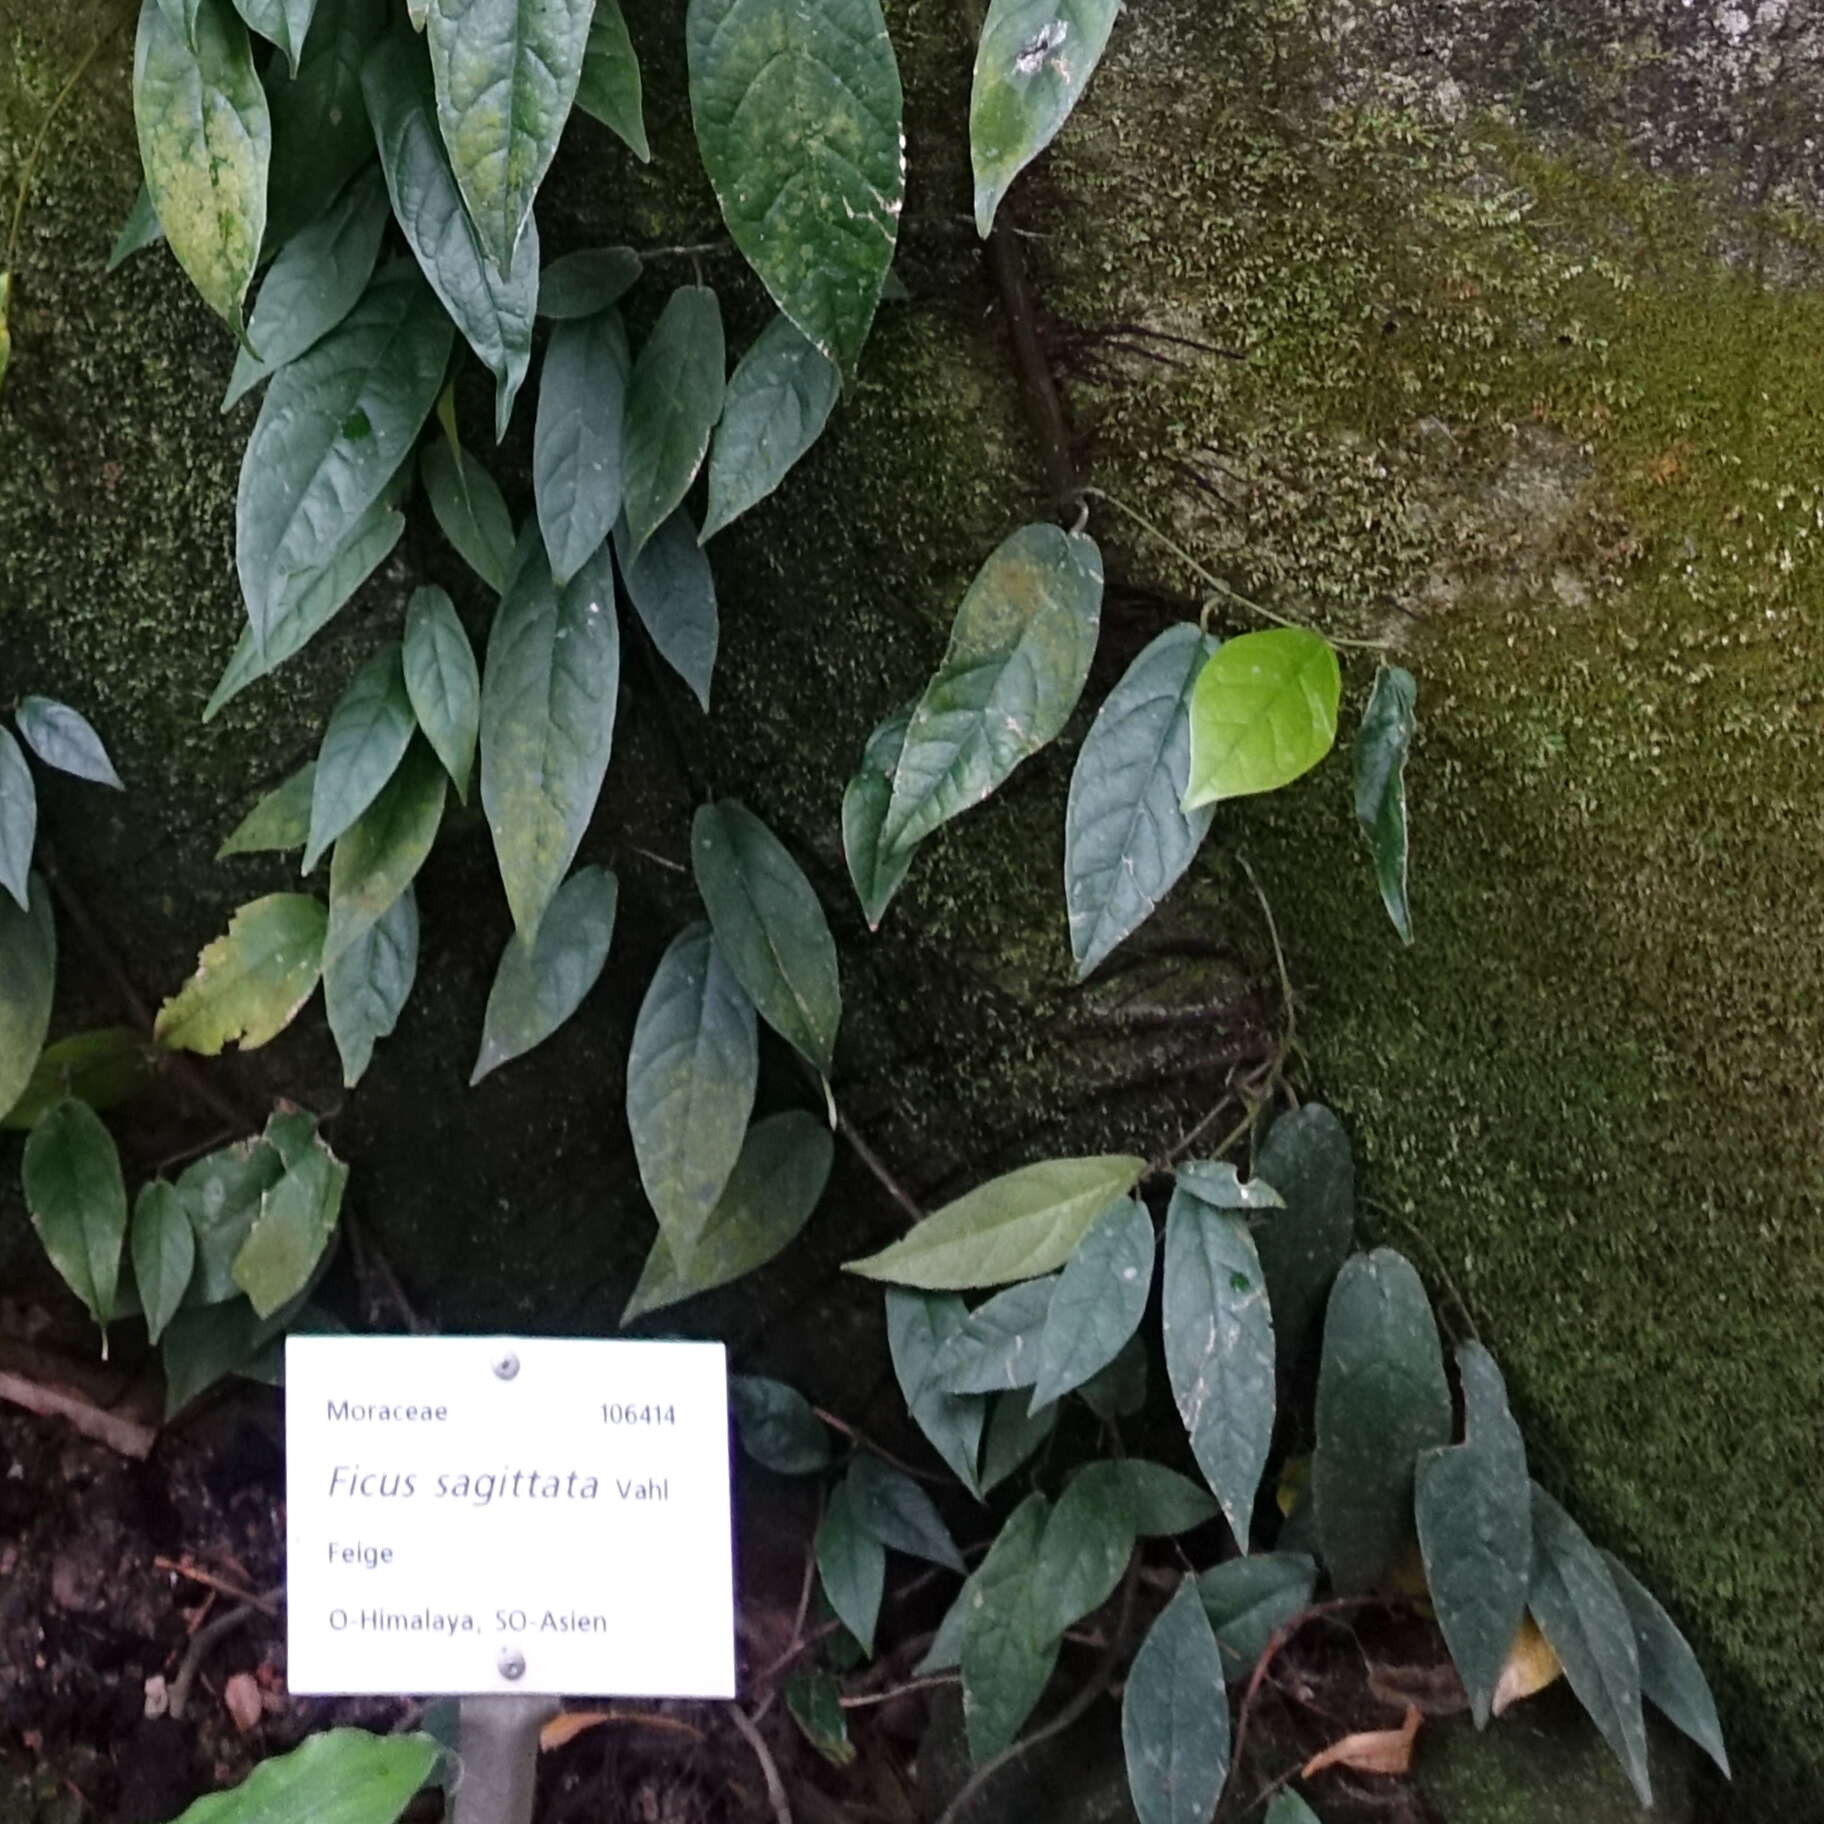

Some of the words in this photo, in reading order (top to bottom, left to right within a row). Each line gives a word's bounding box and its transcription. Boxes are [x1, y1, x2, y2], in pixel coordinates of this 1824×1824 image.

[327, 1400, 447, 1421] Moraceae
[601, 1404, 675, 1425] 106414
[329, 1464, 416, 1498] Ficus
[435, 1466, 598, 1506] sagittata
[616, 1478, 668, 1501] Vahl
[328, 1541, 393, 1570] Feige
[329, 1608, 480, 1636] O-Himalaya,
[496, 1610, 606, 1632] SO-Asien
